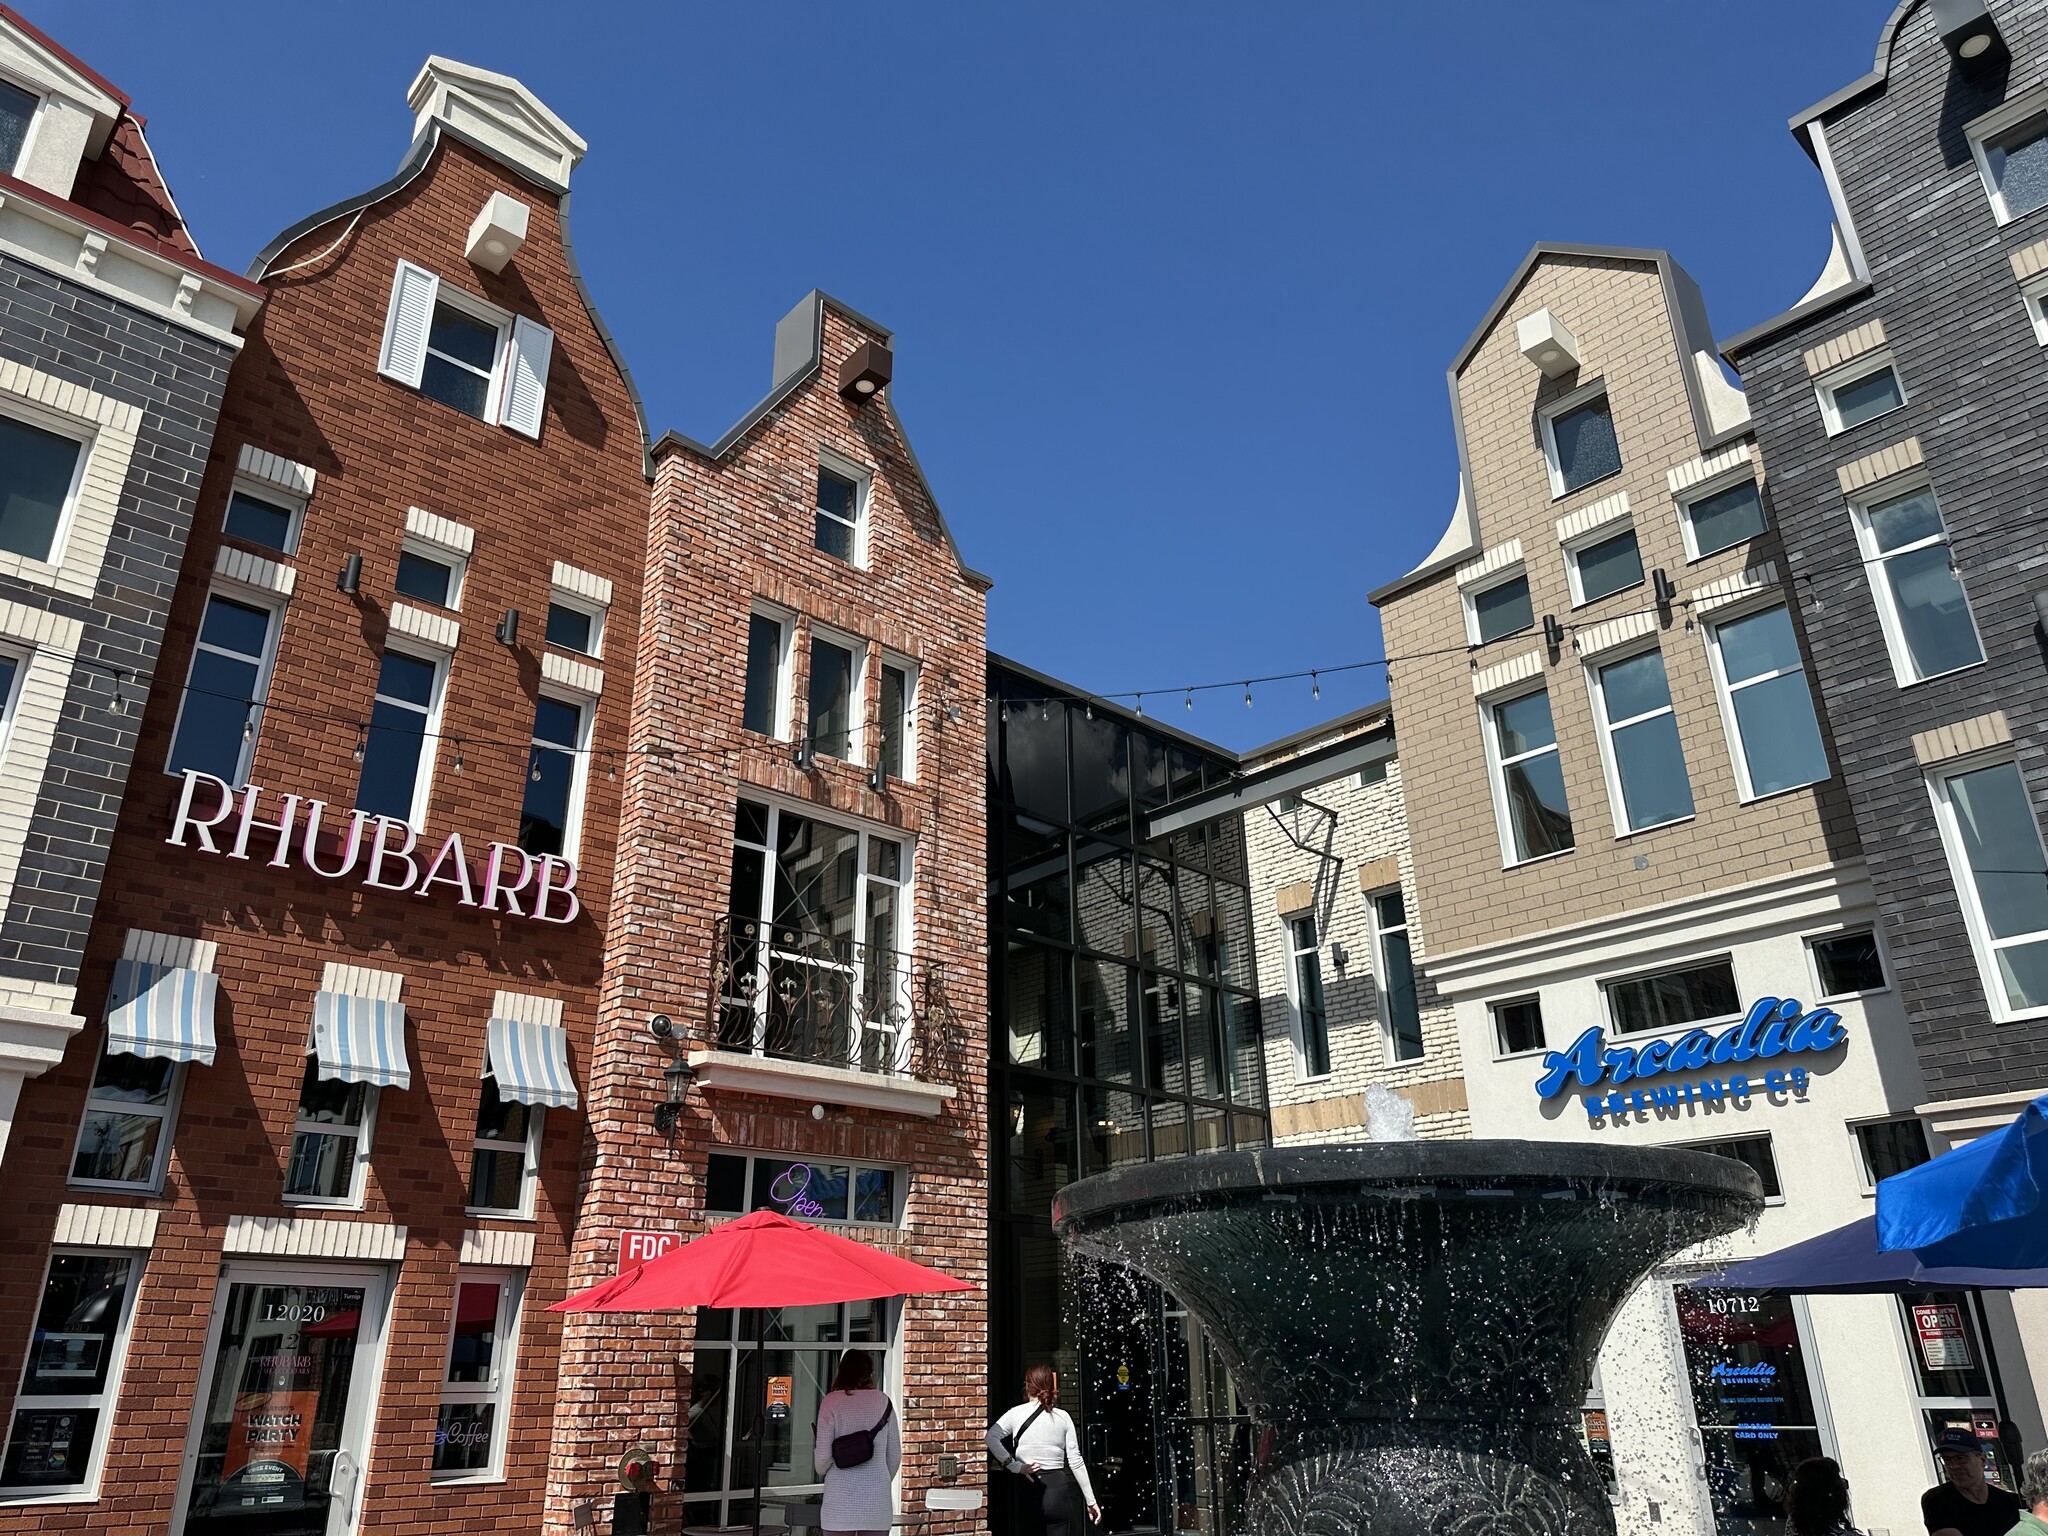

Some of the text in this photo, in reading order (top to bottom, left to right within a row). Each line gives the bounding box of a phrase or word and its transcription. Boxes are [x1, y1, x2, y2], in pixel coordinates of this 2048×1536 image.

[165, 768, 580, 925] RHUBARB
[1535, 996, 1847, 1099] Arcadia
[1585, 1074, 1749, 1117] BREWING
[770, 1163, 824, 1218] Open
[629, 1235, 671, 1260] FDC
[263, 1304, 326, 1322] 12020
[1707, 1297, 1760, 1314] 10712
[1921, 1314, 1956, 1328] OPEN
[260, 1355, 312, 1368] RHUBARB
[1710, 1361, 1777, 1377] Arcadia
[247, 1413, 303, 1428] WATCH
[245, 1429, 300, 1443] PARTY
[447, 1422, 489, 1446] Coffee
[1735, 1431, 1779, 1440] CARD ONLY
[264, 1464, 284, 1473] EVENT
